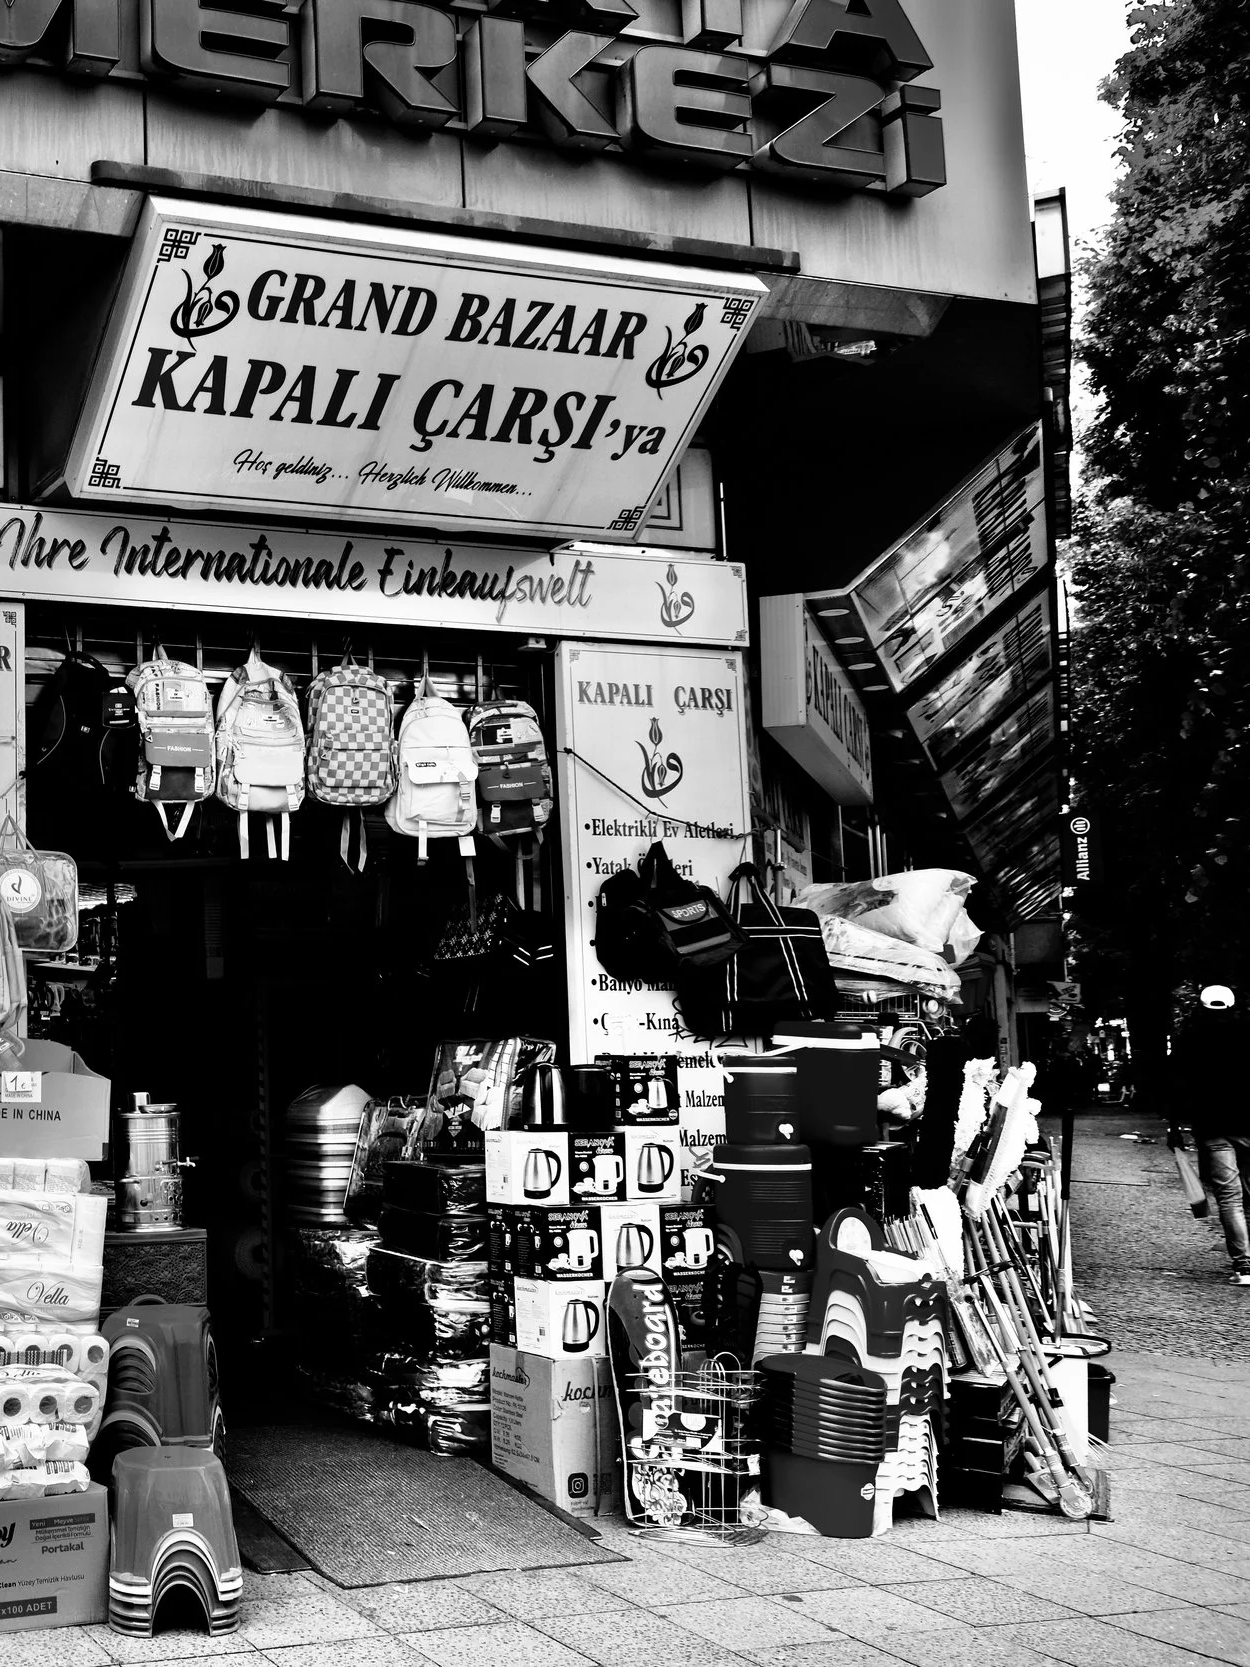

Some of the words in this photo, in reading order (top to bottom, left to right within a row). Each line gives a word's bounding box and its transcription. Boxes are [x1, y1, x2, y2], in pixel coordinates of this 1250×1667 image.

[248, 269, 437, 336] GRAND
[446, 293, 647, 360] BAZAAR
[132, 347, 402, 431] KAPALI
[100, 526, 367, 592] Internationale
[377, 547, 595, 623] Einkaufswelt
[577, 680, 654, 708] KAPALI
[674, 686, 734, 718] ÇARŞI
[591, 818, 658, 839] Elektrikli
[663, 819, 679, 838] Ev
[1075, 837, 1091, 880] Allianz
[671, 903, 706, 919] SPORTS
[13, 1109, 23, 1119] IN
[28, 1109, 61, 1121] CHINA
[27, 1280, 70, 1305] Vella
[41, 1541, 85, 1554] Portakal
[26, 1600, 53, 1613] ADET
